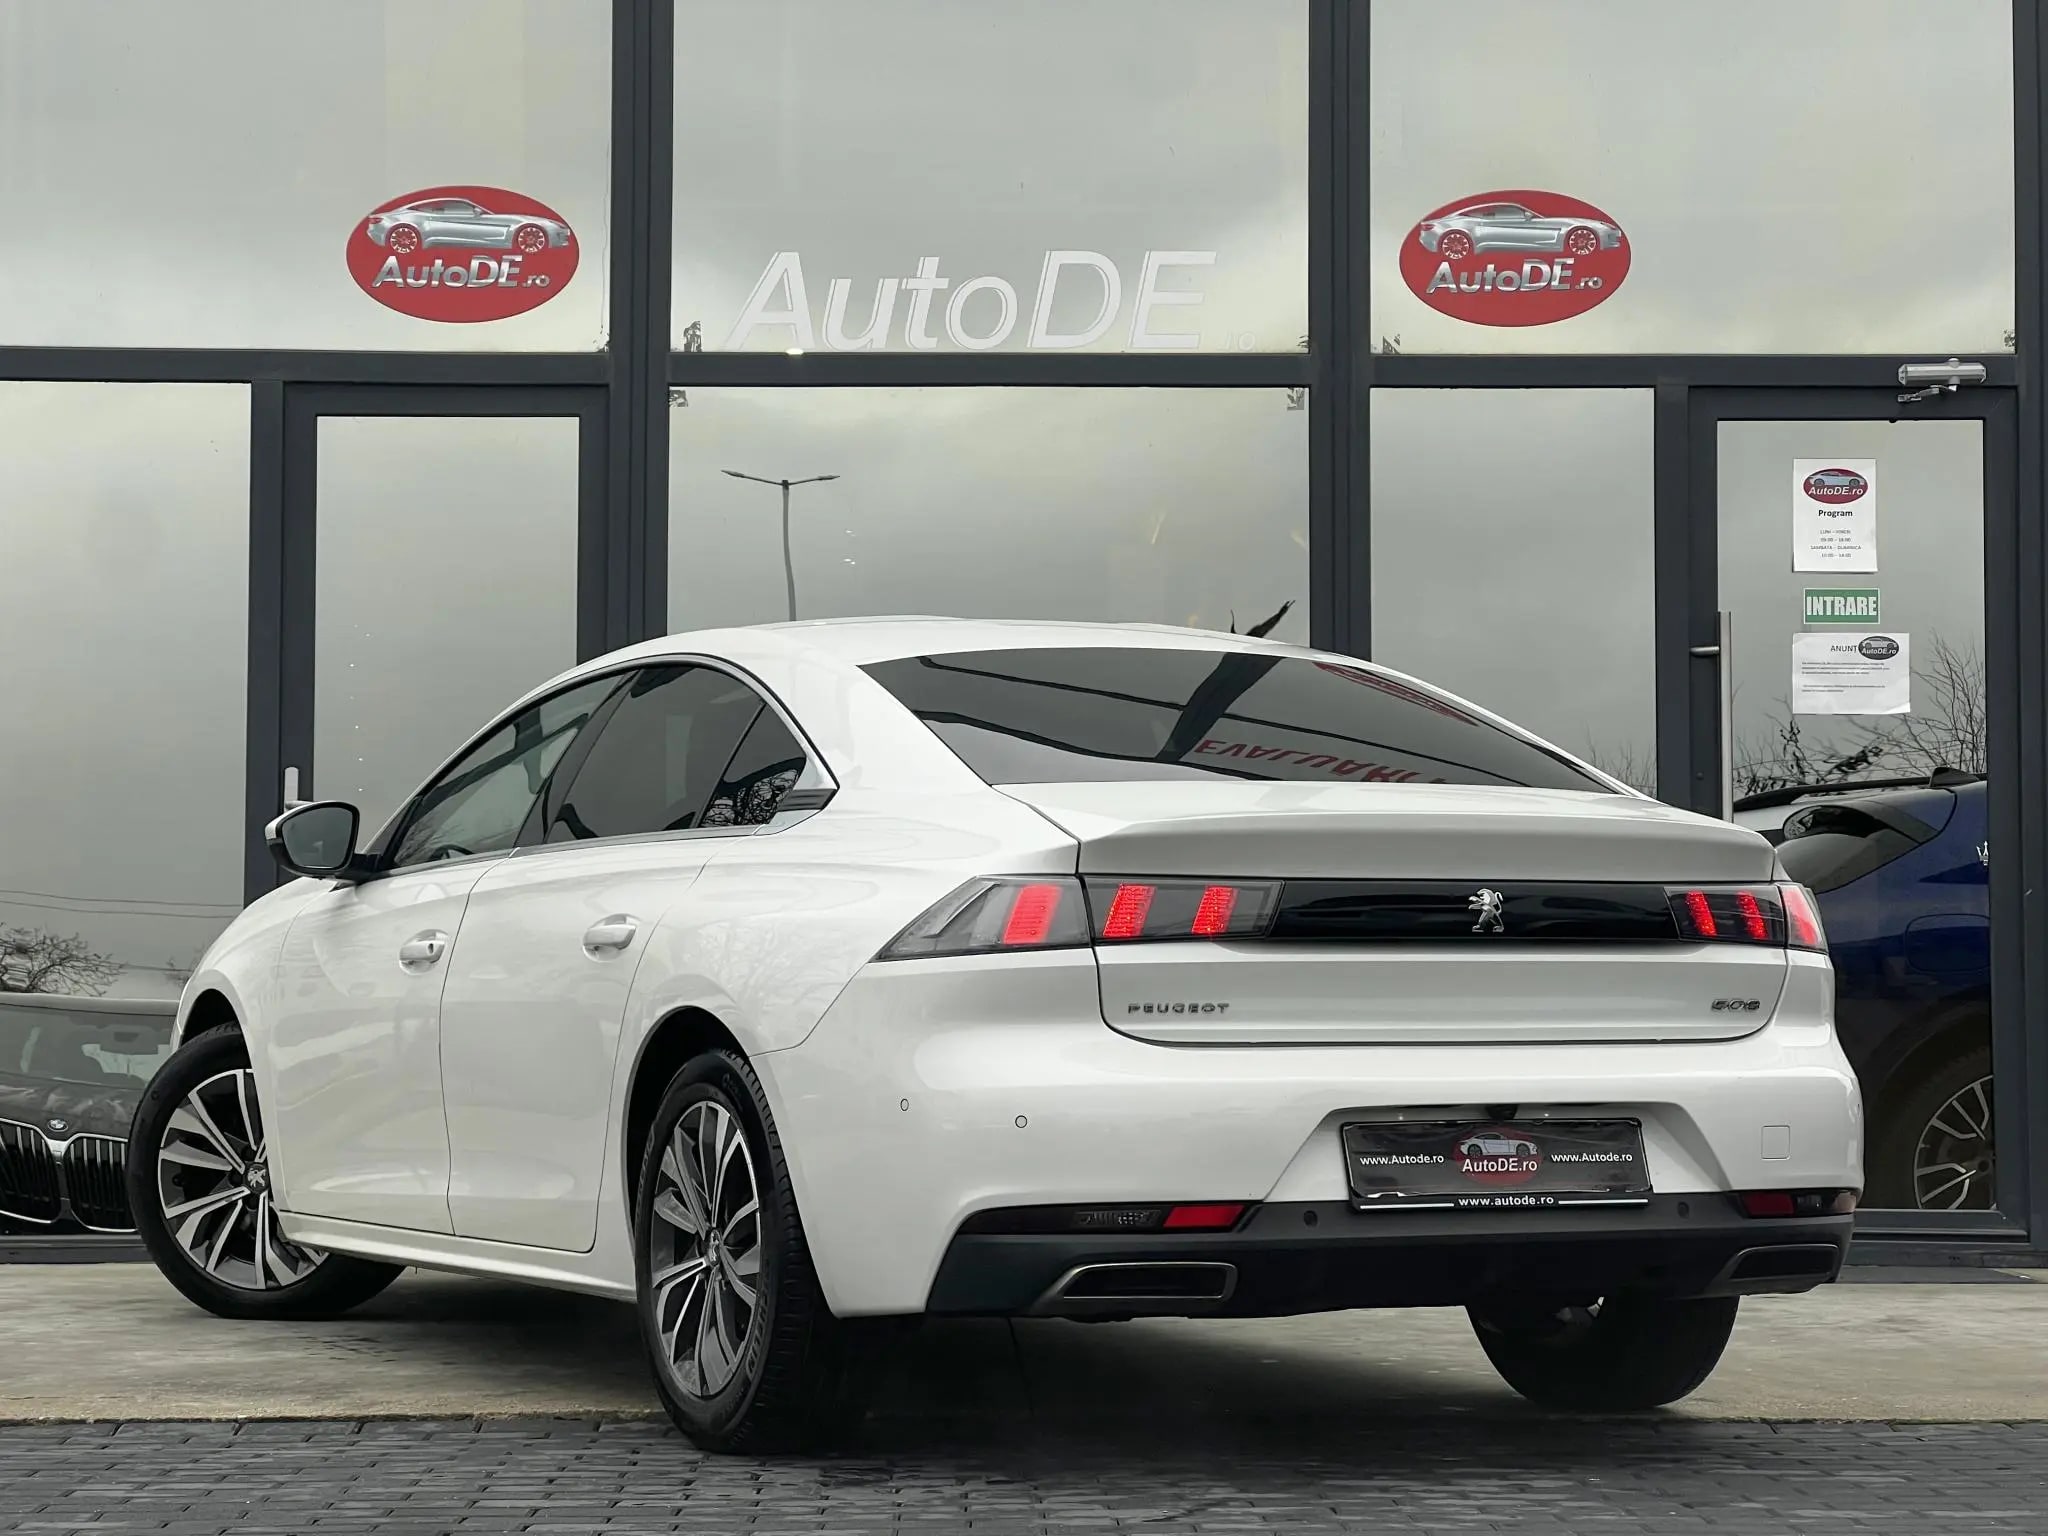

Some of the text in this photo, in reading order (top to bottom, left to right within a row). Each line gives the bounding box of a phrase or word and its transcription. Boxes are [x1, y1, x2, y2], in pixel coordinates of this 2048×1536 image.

[1808, 485, 1864, 497] AutoDE.ro
[1818, 509, 1853, 518] Program
[1806, 596, 1877, 616] INTRARE
[1128, 1003, 1230, 1014] PEUGEOT
[1359, 1152, 1634, 1173] www.Autode.ro AutoDE.ro www.Autode.ro
[1458, 1195, 1554, 1207] www.autode.ro
